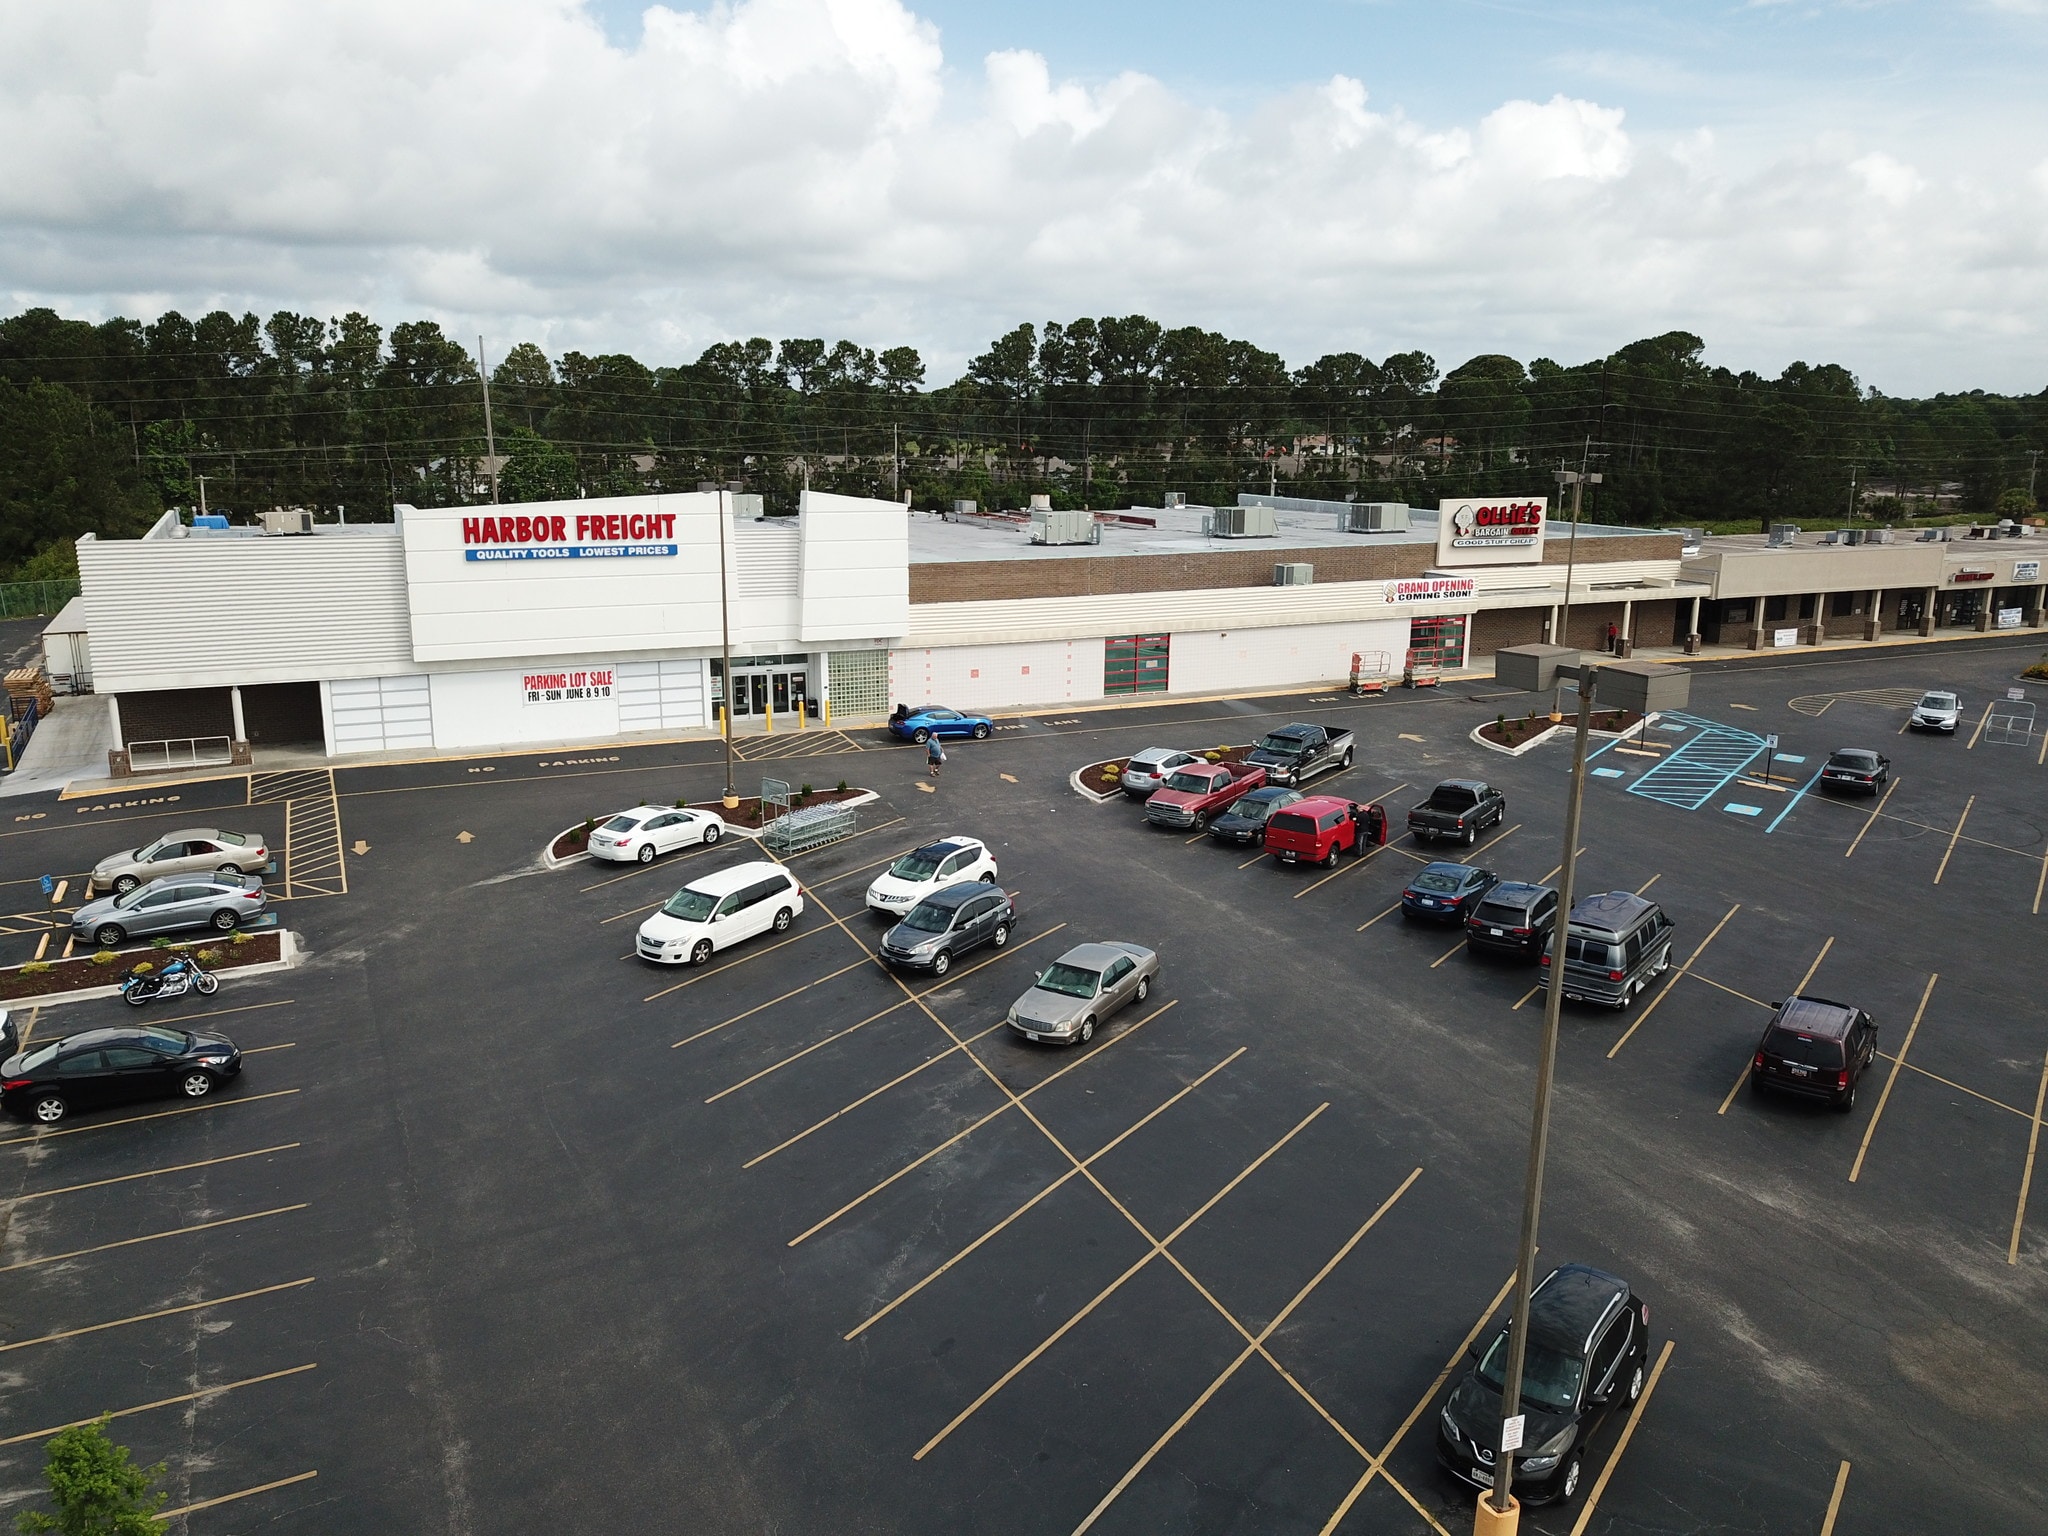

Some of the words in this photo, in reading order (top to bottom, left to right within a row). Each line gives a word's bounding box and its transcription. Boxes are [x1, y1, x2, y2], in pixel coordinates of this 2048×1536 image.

[463, 516, 567, 543] HARBOR
[576, 514, 676, 541] FREIGHT
[1474, 528, 1509, 537] BARGAIN
[476, 550, 528, 559] QUALITY
[530, 548, 570, 558] TOOLS
[580, 547, 624, 557] LOWEST
[628, 546, 669, 556] PRICES
[1398, 582, 1429, 594] GRAND
[1432, 579, 1474, 592] OPENING
[1398, 592, 1441, 601] COMING
[1443, 590, 1471, 598] SOON!
[524, 674, 567, 690] PARKING
[570, 672, 587, 687] LOT
[590, 671, 612, 686] SALE
[566, 688, 583, 699] JUNE
[586, 688, 591, 698] 8
[594, 687, 599, 697] 9
[602, 686, 610, 696] 10
[538, 756, 622, 768] PARKING
[14, 812, 47, 822] NO
[76, 795, 181, 814] PARKING
